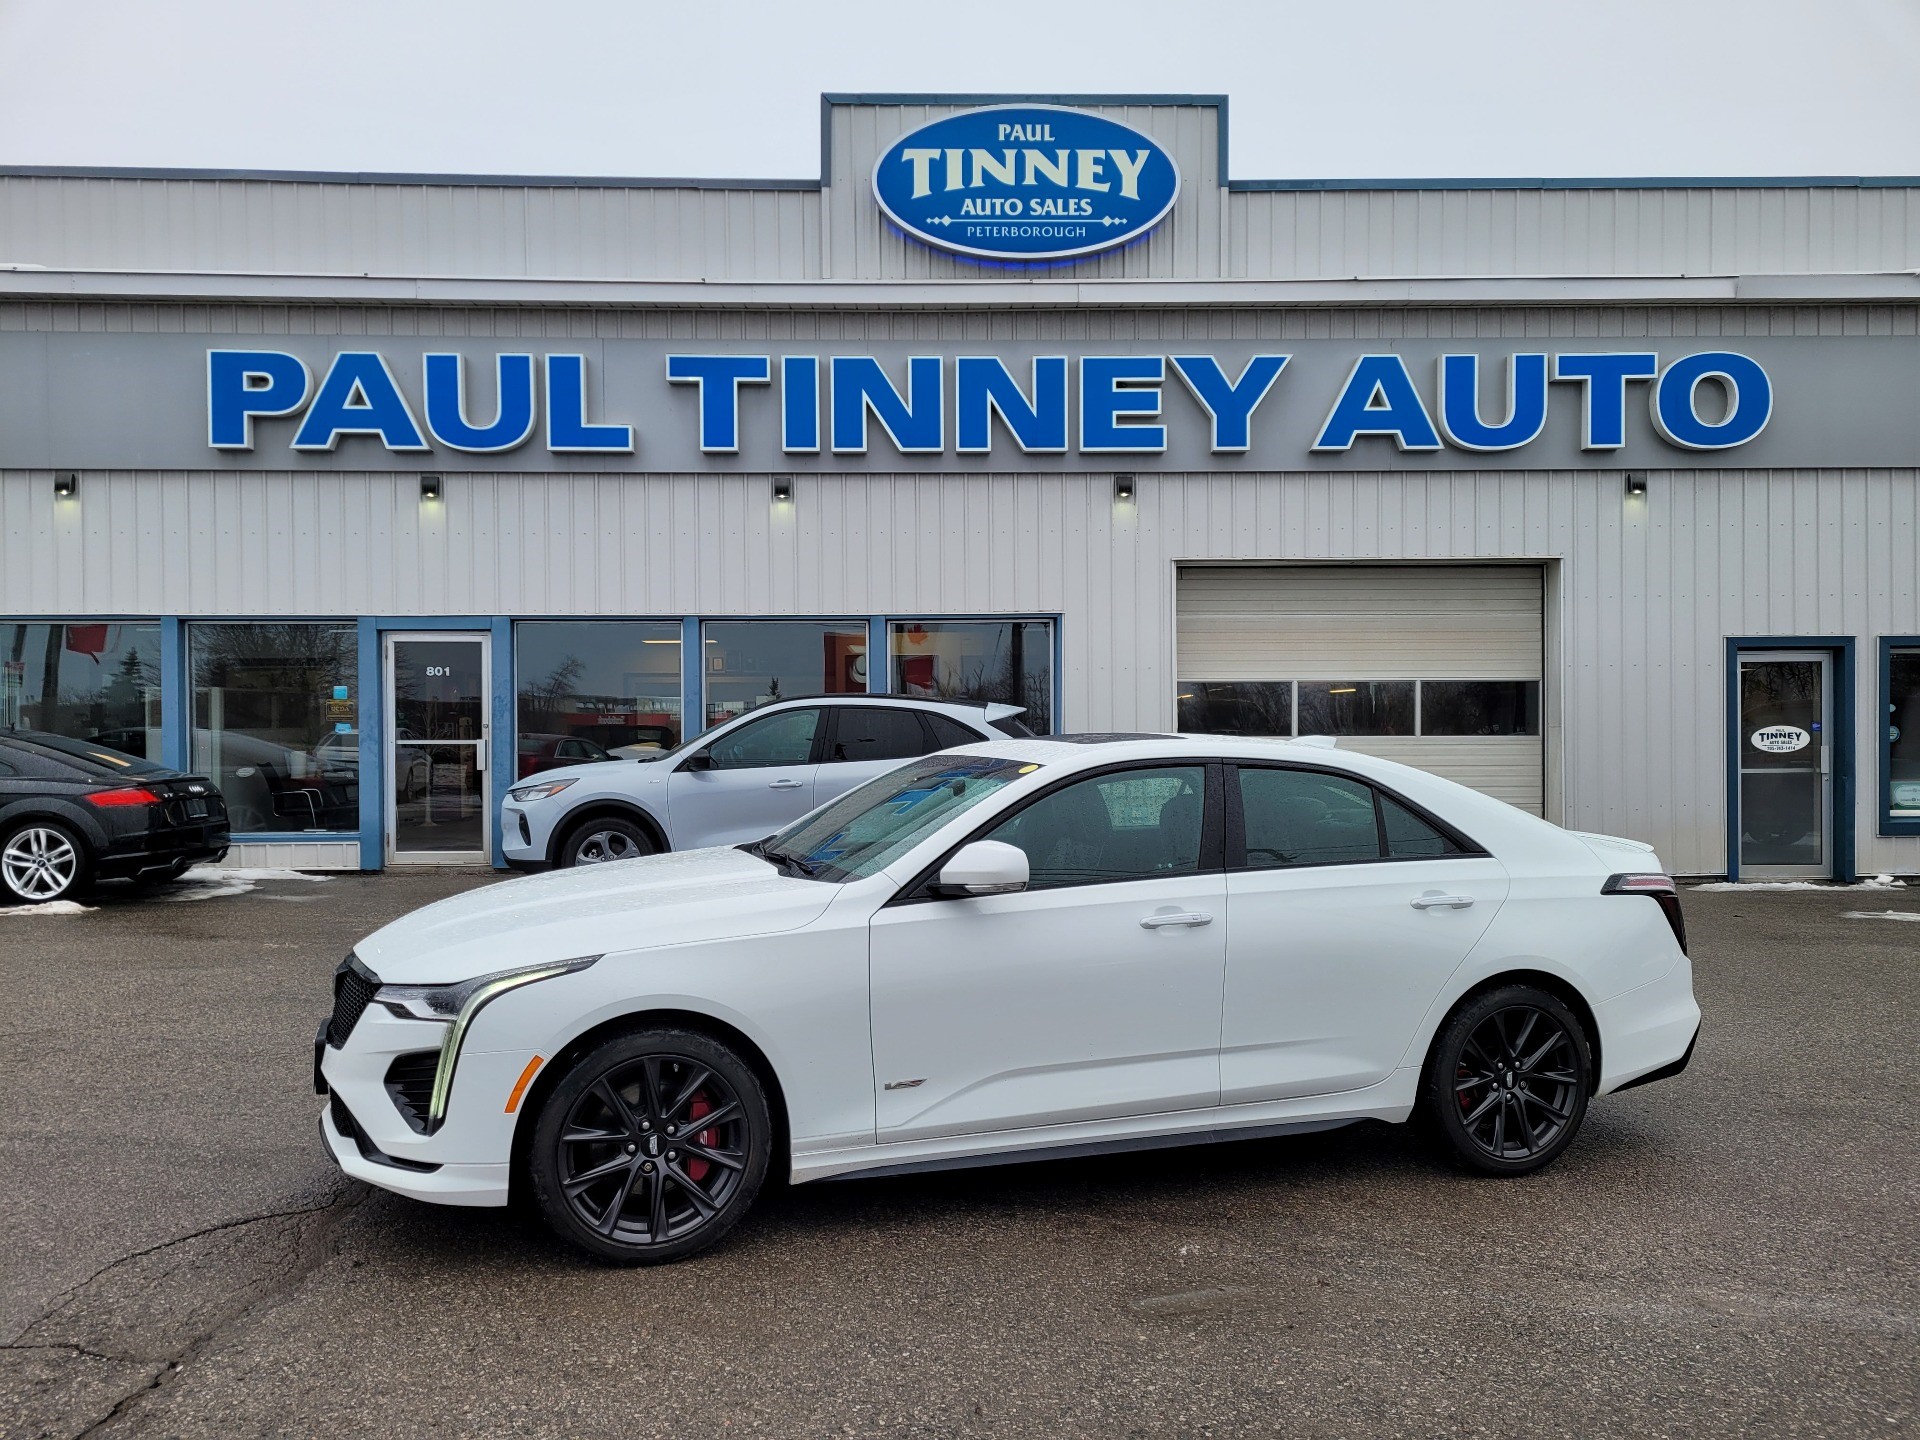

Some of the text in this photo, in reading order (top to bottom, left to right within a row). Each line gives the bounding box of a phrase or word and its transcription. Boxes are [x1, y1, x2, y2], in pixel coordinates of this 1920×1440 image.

[998, 124, 1055, 141] PAUL
[901, 148, 1151, 200] TINNEY
[960, 198, 1093, 216] AUTO SALES
[967, 226, 1086, 237] PETERBOROUGH
[207, 348, 1773, 454] PAUL TINNEY AUTO
[425, 666, 450, 677] 801
[1759, 732, 1802, 742] TINNEY
